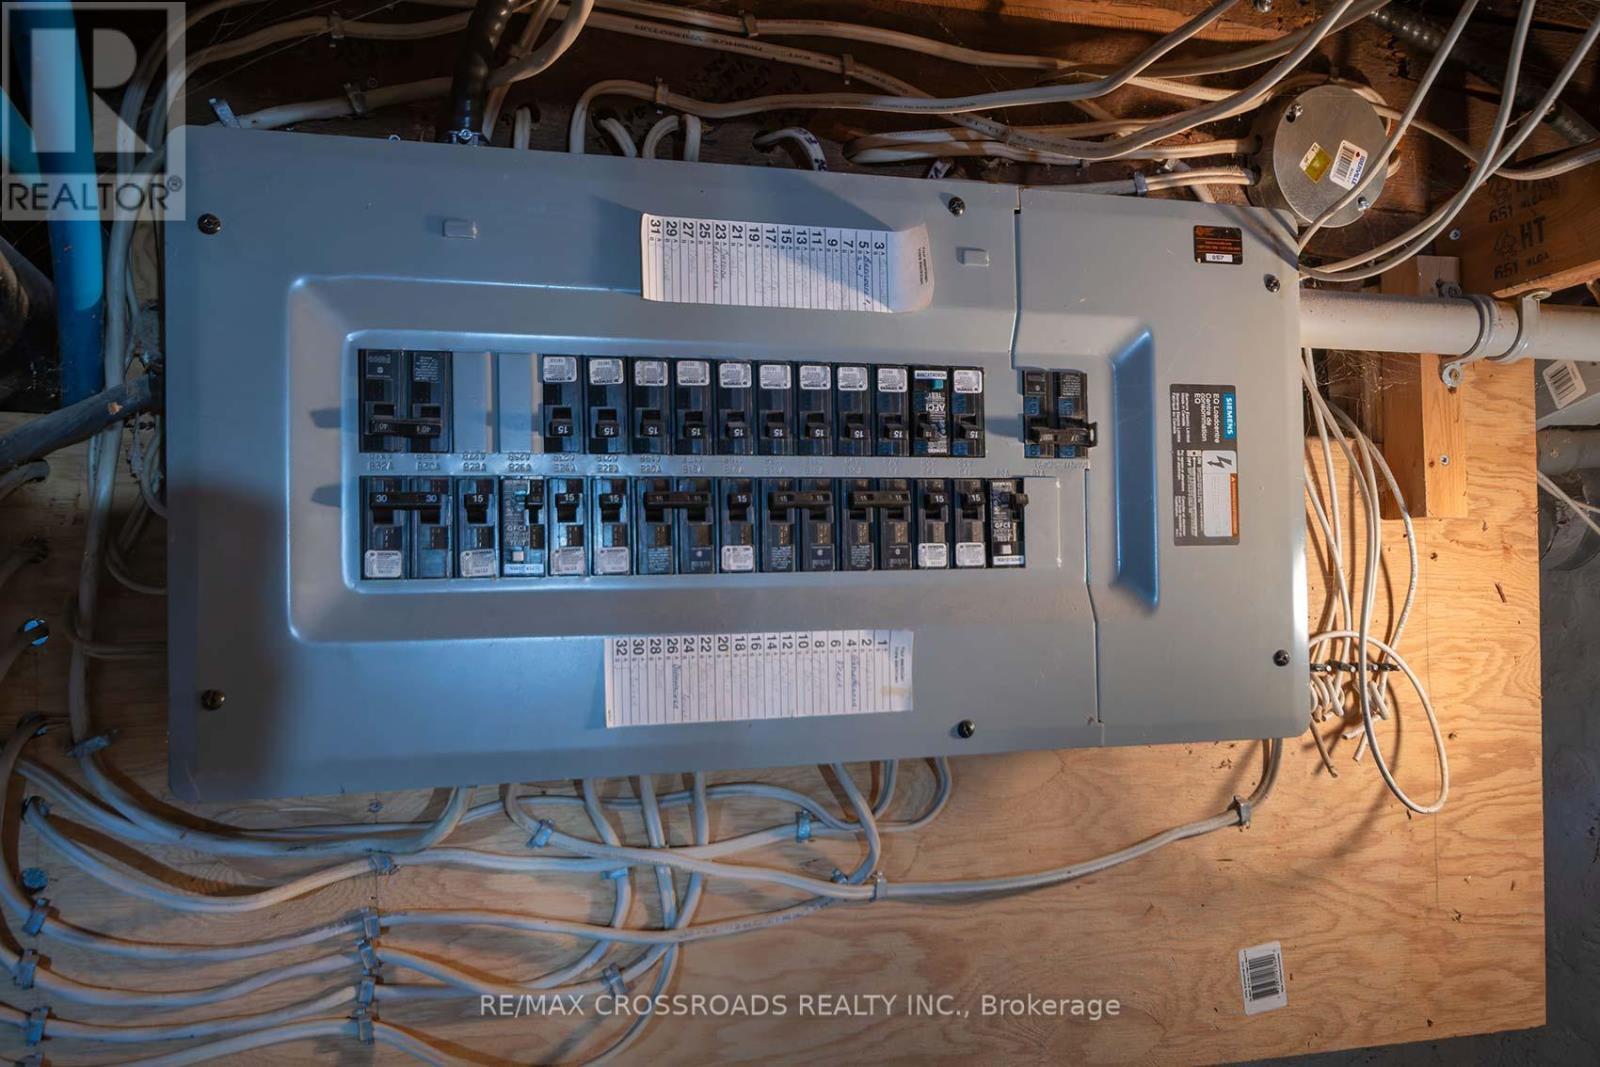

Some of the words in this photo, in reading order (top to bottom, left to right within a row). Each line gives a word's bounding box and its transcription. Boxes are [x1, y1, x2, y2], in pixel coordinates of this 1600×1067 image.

[650, 219, 661, 234] 31
[666, 221, 677, 236] 29
[683, 222, 694, 238] 27
[699, 223, 710, 238] 25
[716, 224, 726, 239] 23
[732, 225, 743, 239] 21
[1520, 216, 1545, 249] HT
[749, 227, 759, 241] 19
[766, 228, 776, 242] 17
[781, 229, 792, 243] 15
[797, 230, 807, 244] 13
[812, 231, 822, 244] 11
[1494, 261, 1518, 279] 651
[1194, 393, 1200, 404] EQ
[1213, 393, 1219, 404] EQ
[1207, 417, 1212, 425] de
[558, 425, 568, 434] 15
[604, 426, 614, 435] 15
[649, 426, 659, 435] 15
[691, 428, 701, 436] 15
[734, 428, 744, 437] 15
[774, 428, 783, 437] 15
[815, 429, 824, 437] 15
[854, 430, 864, 438] 15
[894, 430, 903, 438] 15
[616, 640, 627, 656] 32
[633, 639, 644, 655] 30
[650, 639, 661, 654] 28
[667, 638, 678, 654] 26
[684, 637, 694, 653] 24
[701, 637, 711, 653] 22
[718, 636, 729, 652] 20
[735, 636, 745, 651] 18
[751, 636, 762, 650] 16
[767, 635, 777, 650] 14
[782, 634, 792, 649] 12
[798, 634, 808, 648] 10
